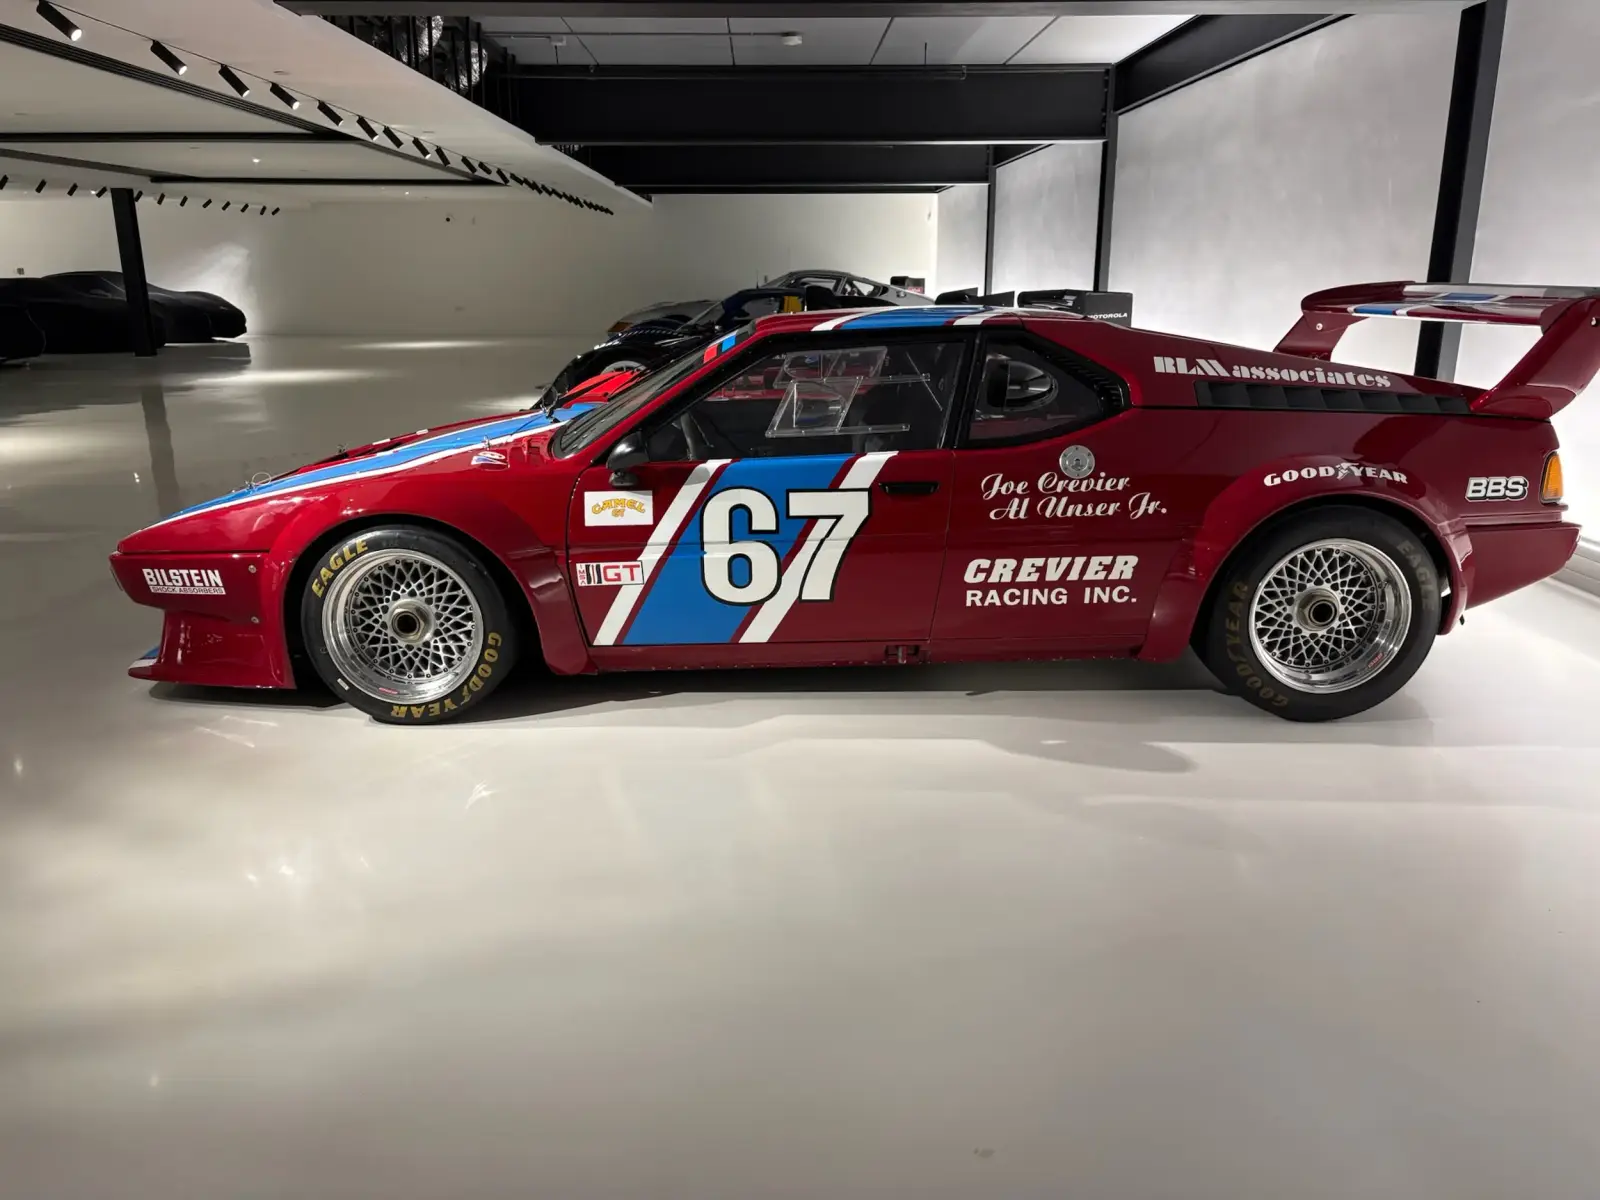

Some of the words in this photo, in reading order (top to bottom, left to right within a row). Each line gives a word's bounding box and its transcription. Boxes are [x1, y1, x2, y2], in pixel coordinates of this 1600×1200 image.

[1232, 364, 1391, 388] associates
[981, 473, 1030, 500] Joe
[1037, 472, 1130, 493] Crevier
[1465, 476, 1529, 502] BBS
[591, 498, 646, 515] CAMEL
[989, 497, 1030, 520] Al
[1037, 496, 1120, 519] Unser
[1128, 492, 1167, 520] Jr.
[700, 486, 872, 607] 67
[142, 568, 224, 587] BILSTEIN
[311, 538, 369, 599] EAGLE
[603, 563, 640, 582] GT
[963, 555, 1139, 584] CREVIER
[1396, 540, 1436, 611] EAGLE
[178, 587, 224, 595] ABSORBERS
[966, 588, 1068, 607] RACING
[1084, 586, 1137, 604] INC.
